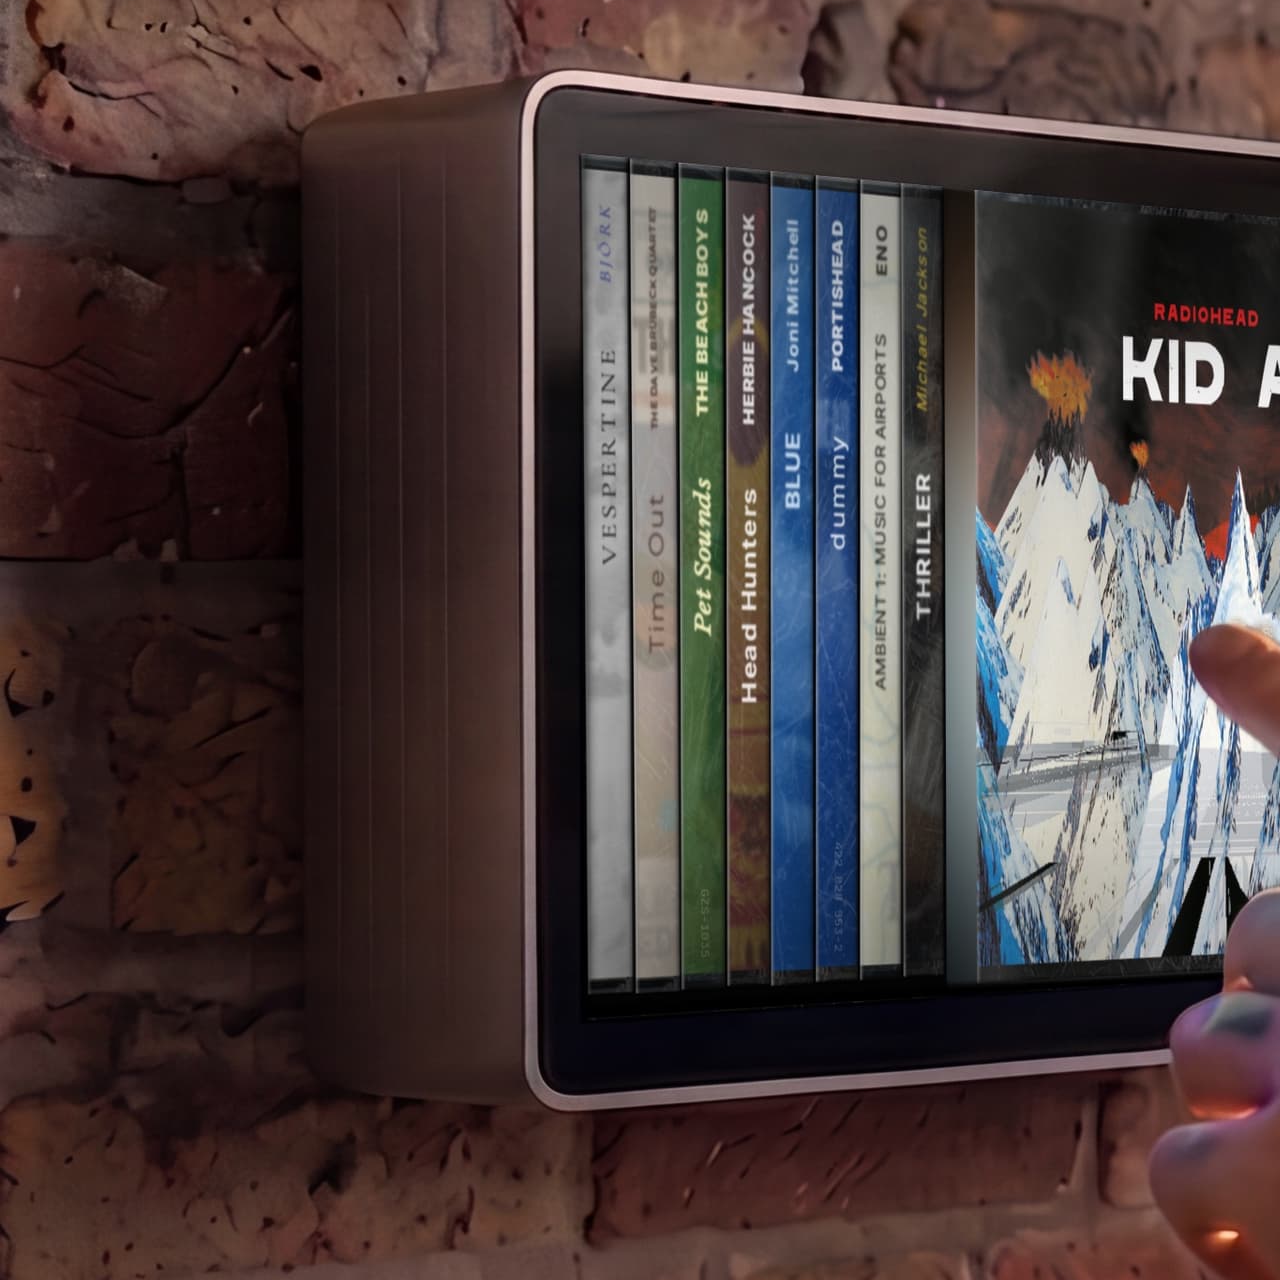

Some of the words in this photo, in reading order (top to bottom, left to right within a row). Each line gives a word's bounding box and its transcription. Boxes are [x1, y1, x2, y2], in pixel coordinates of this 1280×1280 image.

[599, 205, 613, 284] BJÖRK
[648, 207, 657, 276] QUARTET
[696, 208, 709, 278] BOYS
[742, 214, 755, 336] HANCOCK
[786, 219, 799, 315] Mitchell
[876, 225, 888, 276] ENO
[915, 226, 928, 317] Jackson
[696, 281, 709, 365] BEACH
[831, 219, 844, 372] PORTISHEAD
[1154, 303, 1259, 328] RADIOHEAD
[649, 354, 659, 397] DAVE
[742, 341, 755, 425] HERBIE
[786, 322, 800, 372] Joni
[874, 332, 888, 439] AIRPORTS
[915, 325, 928, 412] Michael
[1122, 335, 1225, 405] KID
[650, 400, 659, 429] THE
[696, 370, 709, 417] THE
[601, 348, 617, 565] VESPERTINE
[785, 432, 801, 509] BLUE
[832, 436, 849, 550] dummy
[874, 441, 888, 489] FOR
[648, 494, 665, 557] Out
[692, 477, 712, 580] Sounds
[741, 488, 757, 611] Hunters
[874, 497, 888, 567] MUSIC
[916, 472, 931, 620] THRILLER
[648, 572, 665, 654] Time
[694, 586, 712, 637] Pet
[874, 573, 888, 592] 1:
[741, 623, 757, 704] Head
[874, 596, 888, 690] AMBIENT
